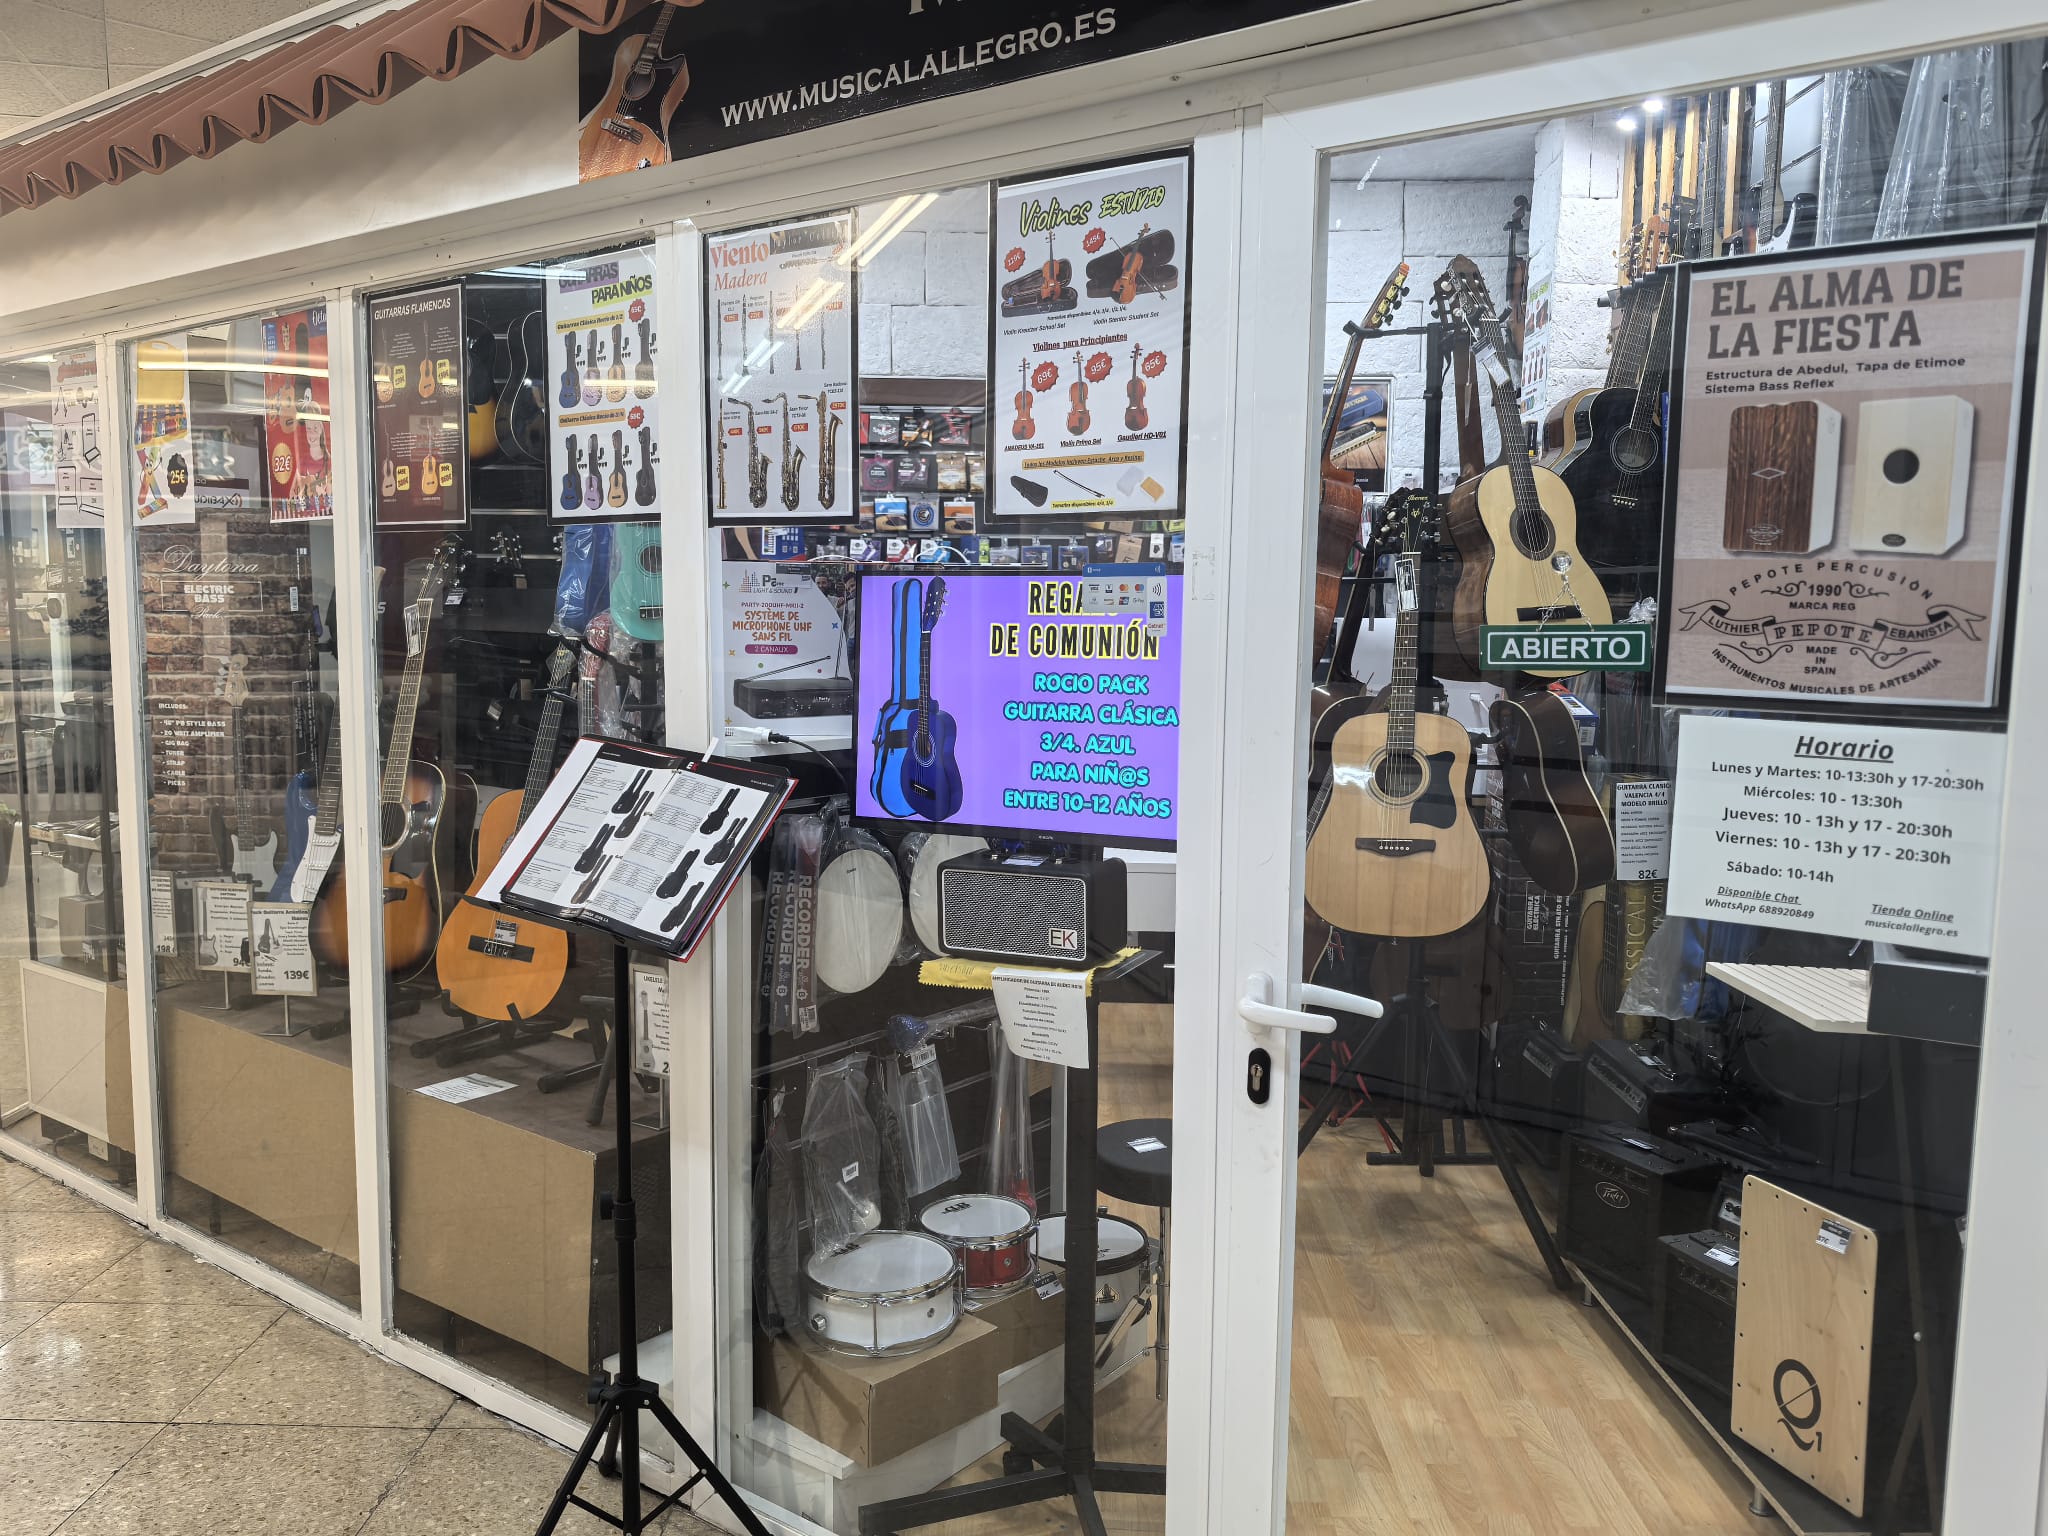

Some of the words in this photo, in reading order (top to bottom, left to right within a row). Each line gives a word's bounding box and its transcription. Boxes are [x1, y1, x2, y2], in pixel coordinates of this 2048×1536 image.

[720, 8, 1117, 128] WWW.MUSICALALLEGRO.ES
[1020, 197, 1092, 237] Violines
[1098, 186, 1166, 219] ESTUDIO
[710, 240, 769, 268] Viento
[714, 268, 768, 291] Madera
[1709, 279, 1755, 317] EL
[1768, 267, 1894, 313] ALMA
[1908, 259, 1964, 300] DE
[591, 284, 619, 304] PARA
[374, 305, 410, 321] GUITARRAS
[410, 297, 451, 316] FLAMENCAS
[1033, 342, 1061, 352] Violines
[1063, 340, 1079, 349] para
[1080, 333, 1128, 346] Principiantes
[1707, 322, 1760, 359] LA
[1773, 310, 1922, 356] FIESTA
[1037, 367, 1052, 384] 69€
[1090, 359, 1107, 375] 95€
[1706, 368, 1773, 381] Estructura
[1777, 366, 1793, 377] de
[1796, 363, 1848, 376] Abedul,
[1856, 361, 1890, 375] Tapa
[1893, 359, 1911, 371] de
[1915, 356, 1966, 369] Etimoe
[1704, 382, 1755, 394] Sistema
[1760, 380, 1790, 392] Bass
[1793, 377, 1835, 390] Reflex
[273, 455, 292, 473] 32€
[170, 469, 185, 484] 25€
[162, 545, 259, 580] Daytona
[184, 585, 235, 594] ELECTRIC
[1729, 563, 1804, 597] PEPOTE
[1816, 562, 1934, 600] PERCUSIÓN
[1807, 584, 1842, 597] 1990
[194, 594, 225, 604] BASS
[1028, 581, 1086, 616] REGA
[1789, 601, 1829, 610] MARCA
[1832, 602, 1856, 611] REG
[745, 606, 785, 621] SYSTÈME
[788, 611, 800, 621] DE
[732, 621, 791, 631] MICROPHONE
[793, 622, 812, 632] UHF
[1708, 615, 1761, 635] LUTHIER
[1774, 623, 1873, 643] PEPOTE
[1889, 620, 1954, 640] EBANISTA
[752, 632, 776, 641] SANS
[779, 632, 793, 641] FIL
[990, 623, 1019, 657] DE
[1028, 618, 1160, 660] COMUNIÓN
[1501, 637, 1631, 660] ABIERTO
[1806, 645, 1837, 655] MADE
[1711, 648, 1786, 690] INSTRUMENTOS
[1789, 684, 1856, 695] MUSICALES
[1859, 682, 1876, 694] DE
[1879, 656, 1943, 691] ARTESANÍA
[1803, 666, 1837, 676] SPAIN
[1815, 656, 1827, 665] IN
[1033, 672, 1094, 694] ROCIO
[1097, 673, 1150, 695] PACK
[1003, 701, 1095, 724] GUITARRA
[1097, 700, 1180, 727] CLÁSICA
[1040, 732, 1080, 754] 3/4.
[1085, 734, 1136, 756] AZUL
[1794, 735, 1894, 763] Horario
[1031, 762, 1080, 784] PARA
[1083, 761, 1150, 788] NIÑ@S
[1711, 761, 1752, 775] Lunes
[1755, 766, 1763, 778] y
[1767, 764, 1821, 780] Martes:
[1825, 769, 1894, 785] 10-13:30h
[1897, 774, 1907, 788] y
[1911, 775, 1984, 792] 17-20:30h
[1003, 789, 1059, 811] ENTRE
[1062, 793, 1111, 815] 10-12
[1114, 794, 1172, 818] AÑOS
[1744, 785, 1815, 802] Miércoles:
[1819, 791, 1837, 804] 10
[1850, 793, 1903, 810] 13:30h
[1722, 807, 1779, 825] Jueves:
[1783, 812, 1801, 825] 10
[1815, 814, 1844, 830] 13h
[1848, 820, 1859, 834] y
[1863, 818, 1882, 833] 17
[1896, 822, 1953, 839] 20:30h
[1715, 830, 1778, 849] Viernes:
[1782, 837, 1800, 851] 10
[1814, 840, 1843, 855] 13h
[1846, 846, 1858, 860] y
[1862, 844, 1881, 858] 17
[1895, 847, 1951, 865] 20:30h
[1638, 869, 1658, 880] 82€
[1726, 861, 1783, 878] Sábado:
[1786, 867, 1834, 883] 10-14h
[1717, 885, 1772, 902] Disponible
[1773, 891, 1801, 905] Chat
[1526, 895, 1534, 930] GUITARRA
[1704, 898, 1757, 914] WhatsApp
[1758, 903, 1815, 920] 688920849
[1871, 903, 1912, 920] Tienda
[1914, 907, 1955, 924] Online
[796, 874, 813, 970] RECORDER
[1864, 918, 1959, 938] musicalallegro.es
[1050, 930, 1076, 949] EK
[283, 970, 310, 980] 139€
